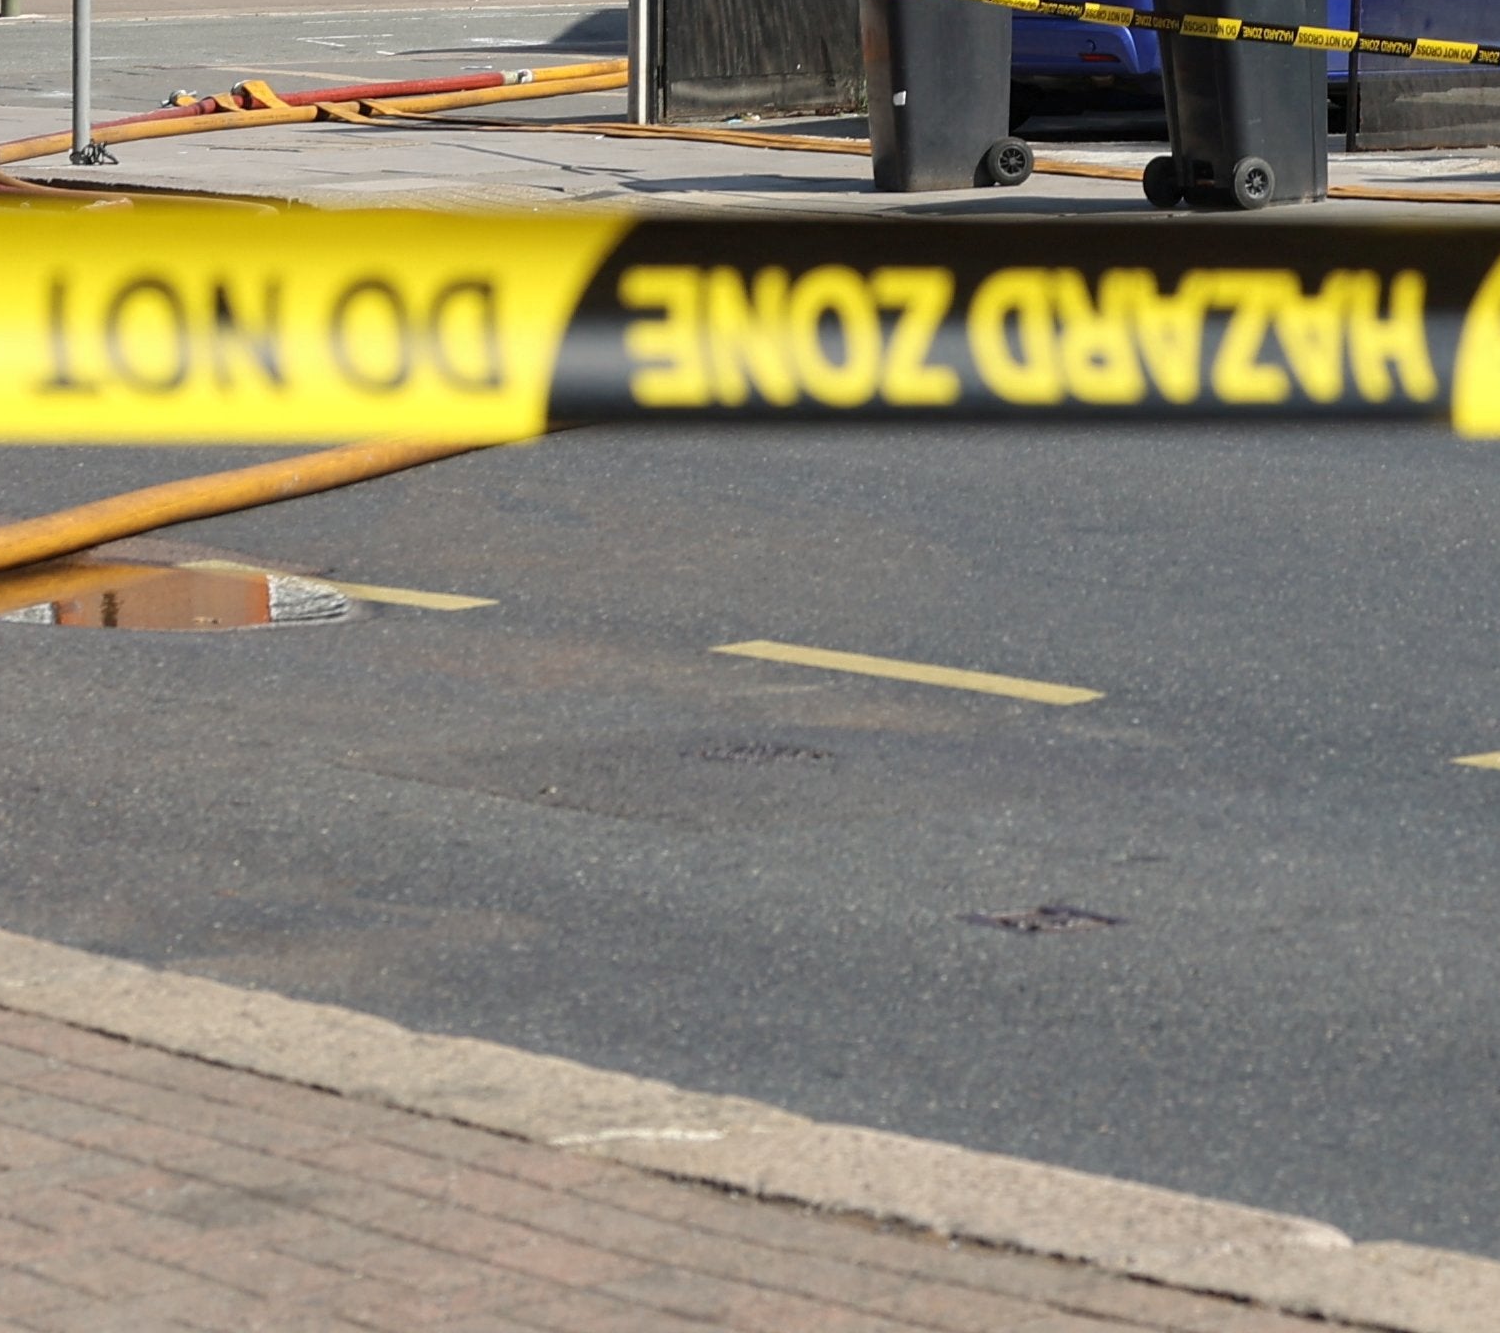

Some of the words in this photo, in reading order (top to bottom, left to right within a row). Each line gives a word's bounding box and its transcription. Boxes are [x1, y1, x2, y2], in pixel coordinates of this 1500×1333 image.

[1135, 14, 1151, 26] ZONE
[1152, 16, 1180, 29] HAZARD
[1243, 26, 1262, 39] ZONE
[1263, 28, 1294, 42] HAZARD
[1298, 33, 1324, 45] CROSS
[1325, 35, 1340, 46] NOT
[1341, 36, 1353, 47] DO
[1359, 38, 1379, 51] ZONE
[1381, 39, 1412, 54] HAZARD
[1417, 44, 1442, 57] CROSS
[1443, 46, 1459, 58] NOT
[1461, 48, 1472, 59] DO
[1478, 49, 1500, 62] ZONE
[35, 271, 289, 396] NOT
[326, 275, 511, 393] DO
[618, 263, 961, 408] ZONE
[967, 266, 1438, 407] HAZARD
